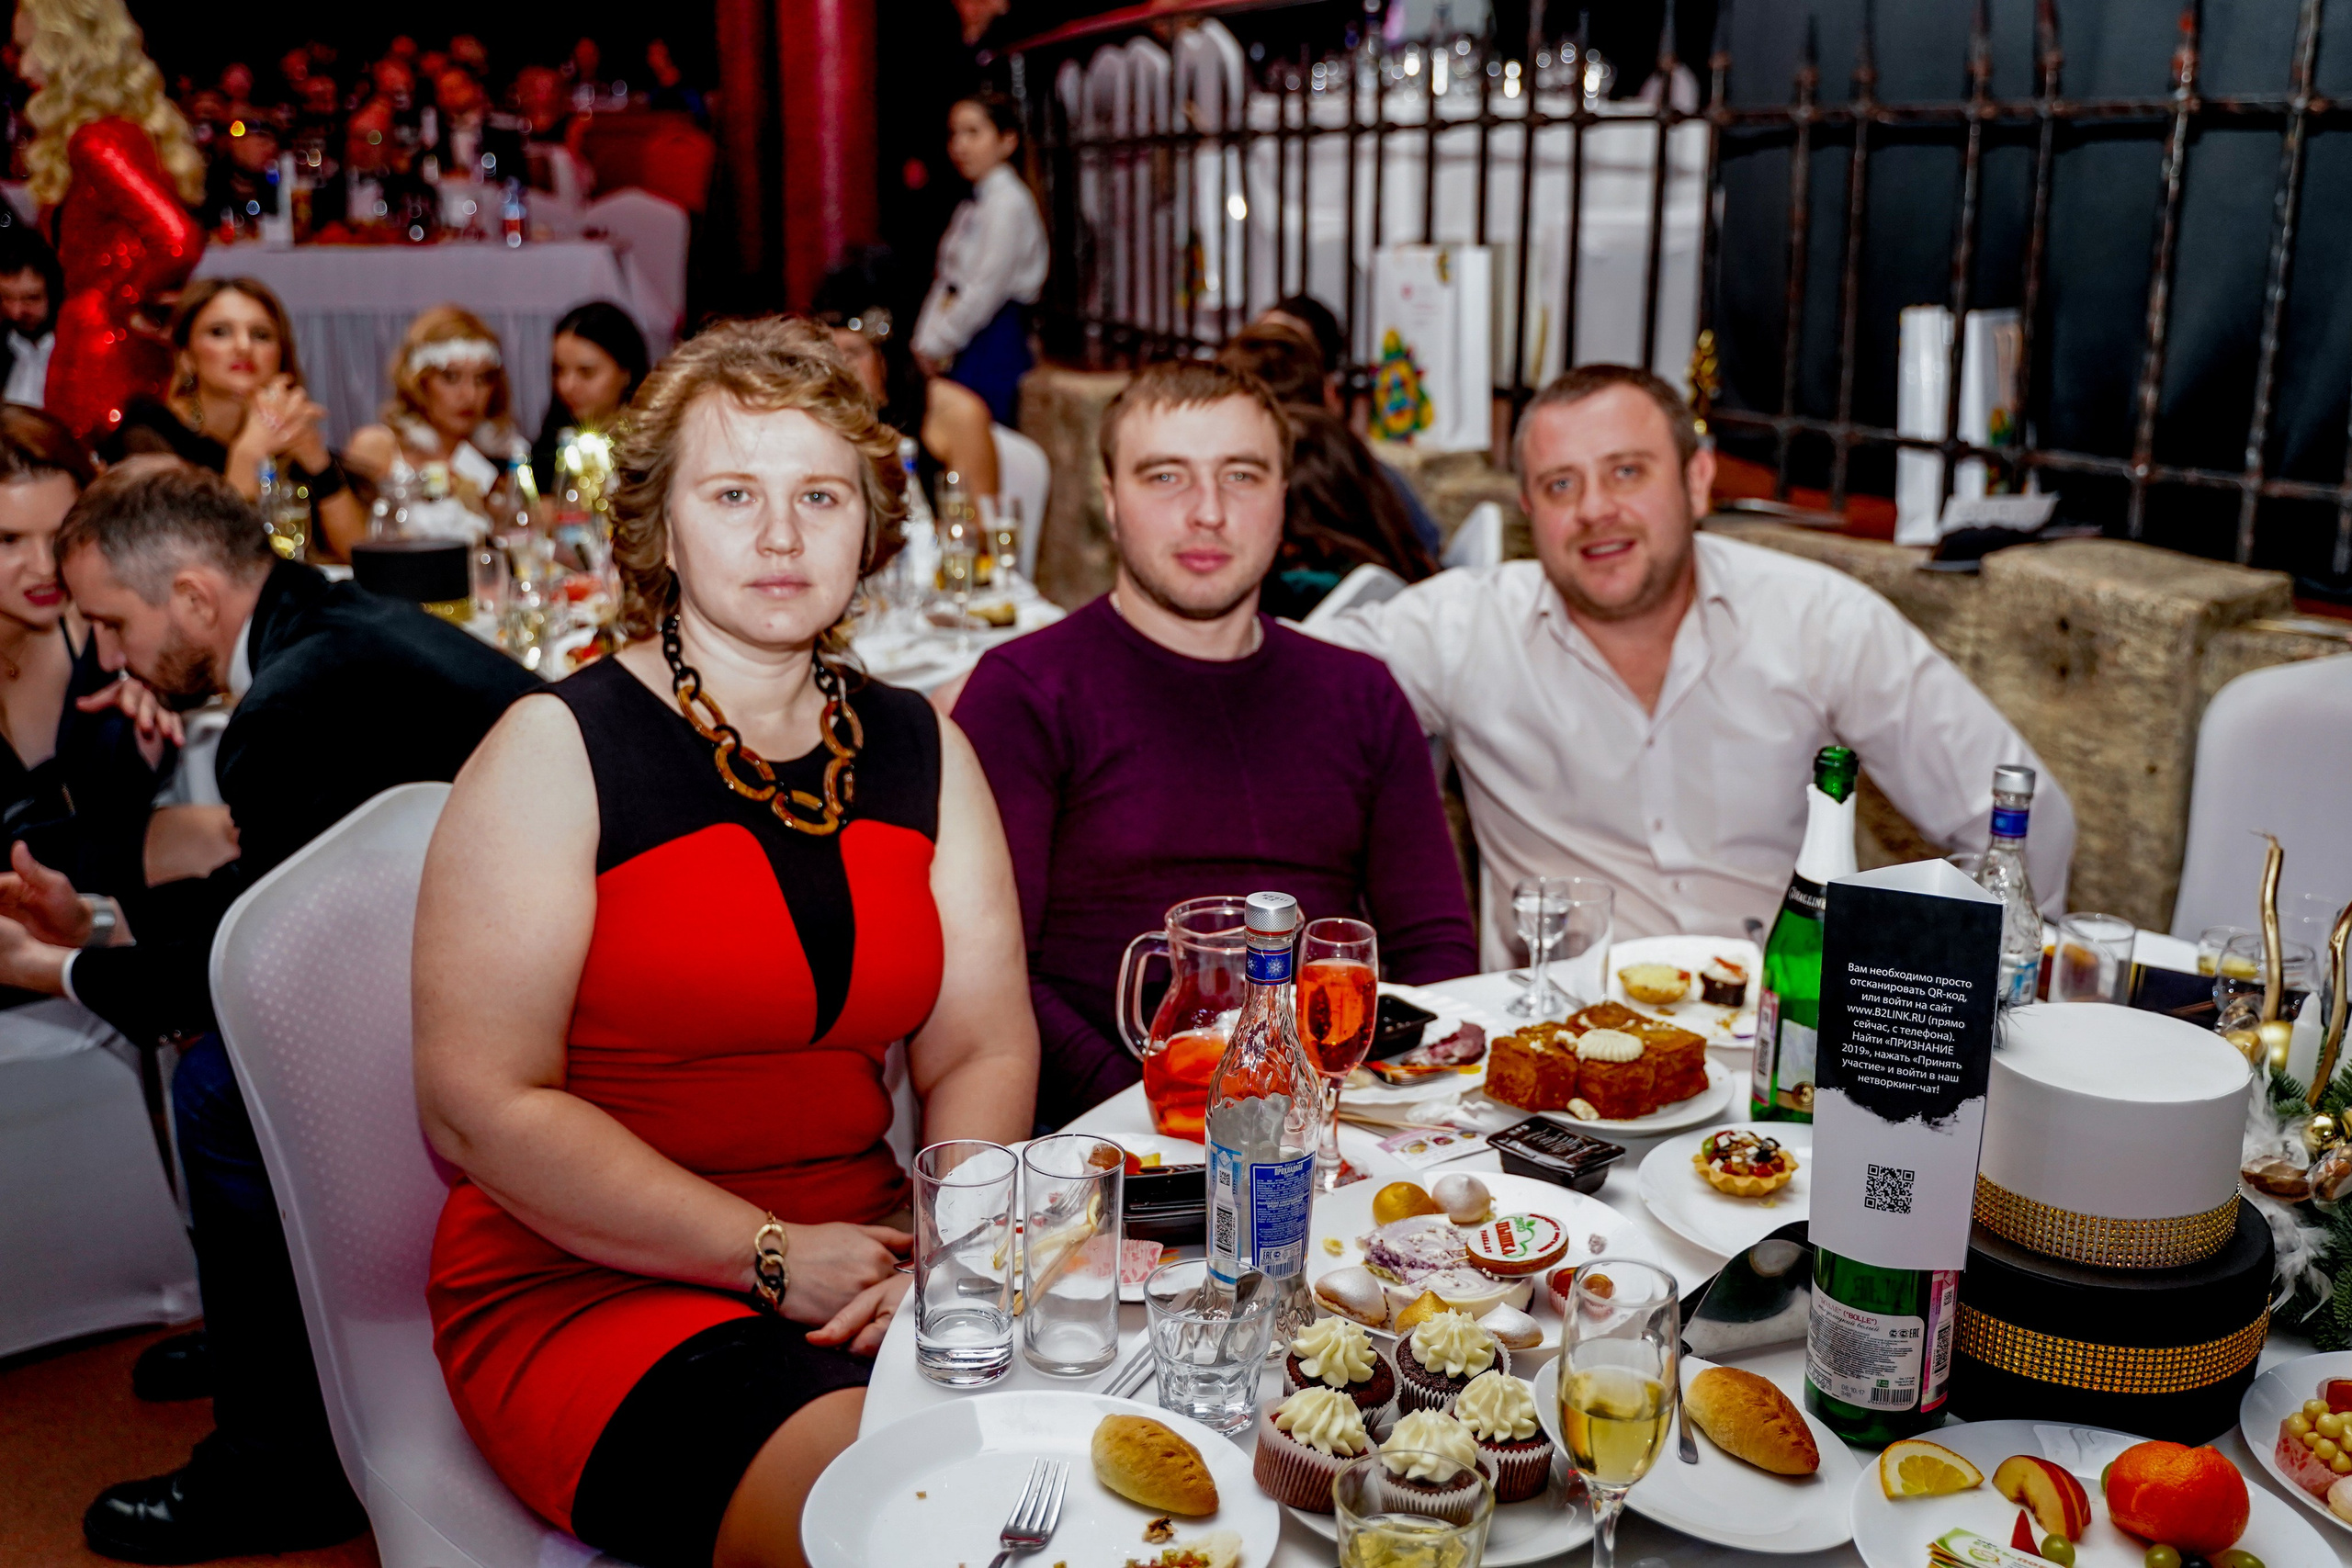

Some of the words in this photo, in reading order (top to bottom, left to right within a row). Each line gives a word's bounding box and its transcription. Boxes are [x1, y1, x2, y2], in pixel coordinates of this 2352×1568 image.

[1848, 963, 1868, 974] Вам
[1870, 967, 1933, 983] необходимо
[1935, 976, 1973, 988] просто
[1849, 978, 1926, 996] отсканировать
[1928, 987, 1967, 1003] QR-код,
[1861, 994, 1881, 1003] или
[1883, 997, 1913, 1008] войти
[1915, 1001, 1928, 1010] на
[1929, 1003, 1953, 1013] сайт
[1847, 1005, 1926, 1023] www.B2LINK.RU
[1928, 1015, 1965, 1029] (прямо
[1852, 1031, 1883, 1044] Найти
[1885, 1037, 1954, 1055] «ПРИЗНАНИЕ
[1853, 1020, 1890, 1033] сейчас,
[1900, 1027, 1955, 1043] телефона).
[1841, 1043, 1872, 1057] 2019»,
[1874, 1051, 1911, 1063] нажать
[1913, 1055, 1962, 1069] «Принять
[1842, 1058, 1885, 1072] участие»
[1896, 1067, 1927, 1078] войти
[1938, 1074, 1959, 1083] наш
[1858, 1075, 1939, 1094] нетворкинг-чат!
[1495, 1221, 1517, 1256] ПЫШКА
